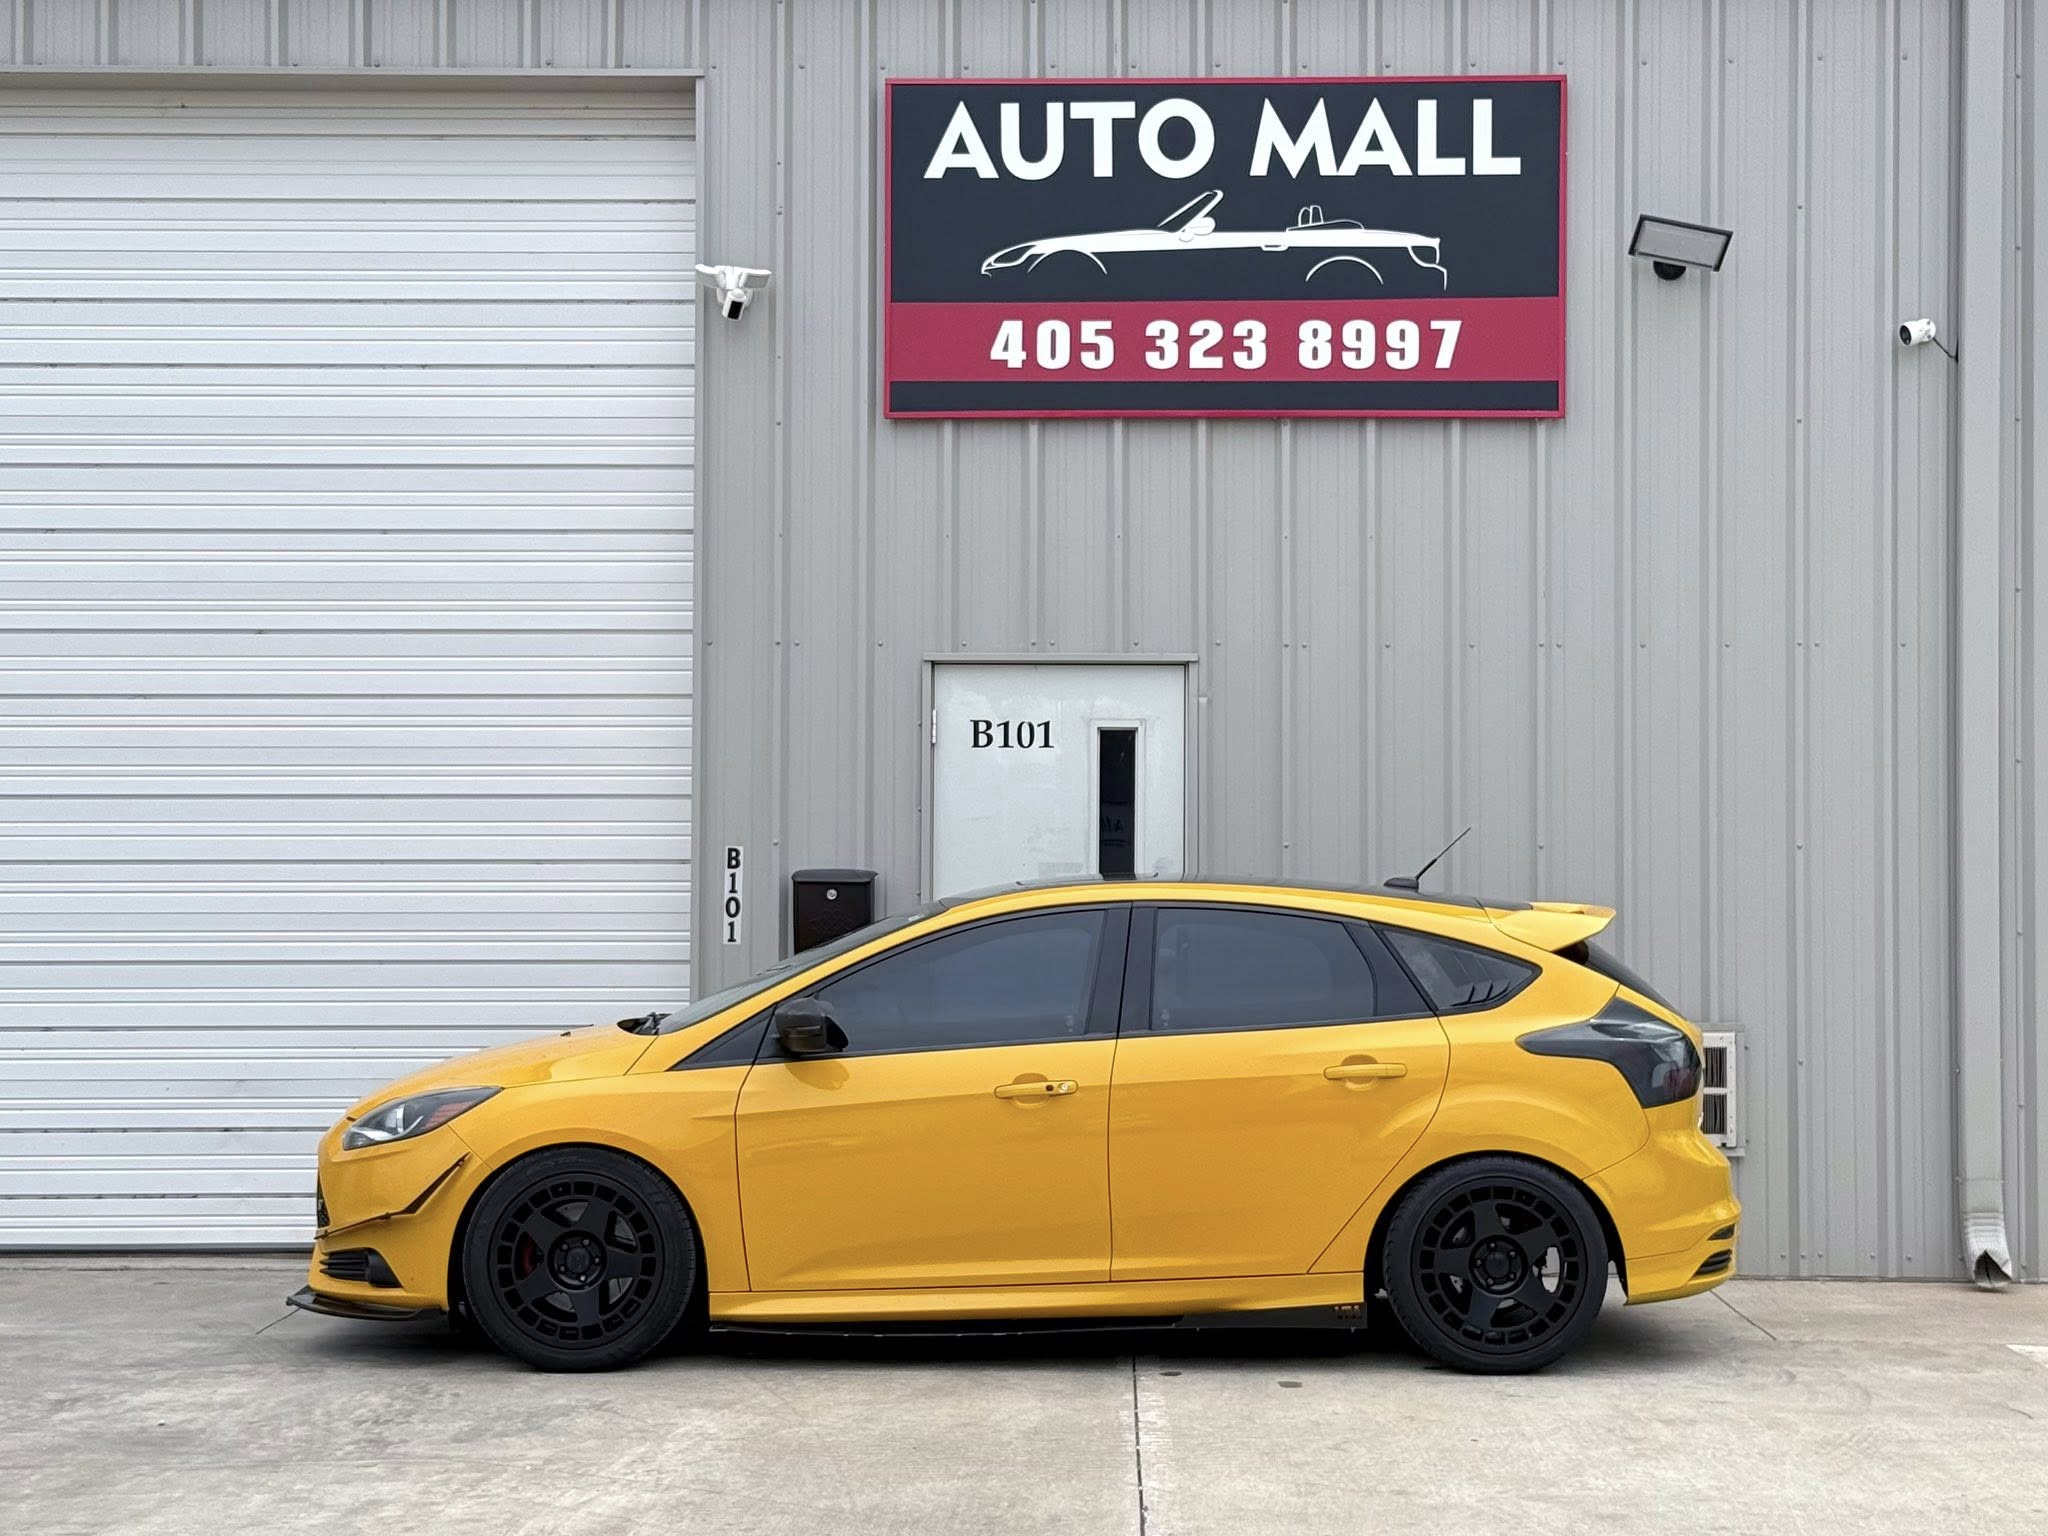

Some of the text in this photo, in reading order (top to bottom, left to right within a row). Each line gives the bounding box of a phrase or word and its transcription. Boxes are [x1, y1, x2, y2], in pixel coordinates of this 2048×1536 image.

[923, 97, 1522, 181] AUTO MALL
[990, 319, 1462, 370] 405 323 8997
[969, 719, 1054, 749] B101
[725, 847, 741, 943] B101
